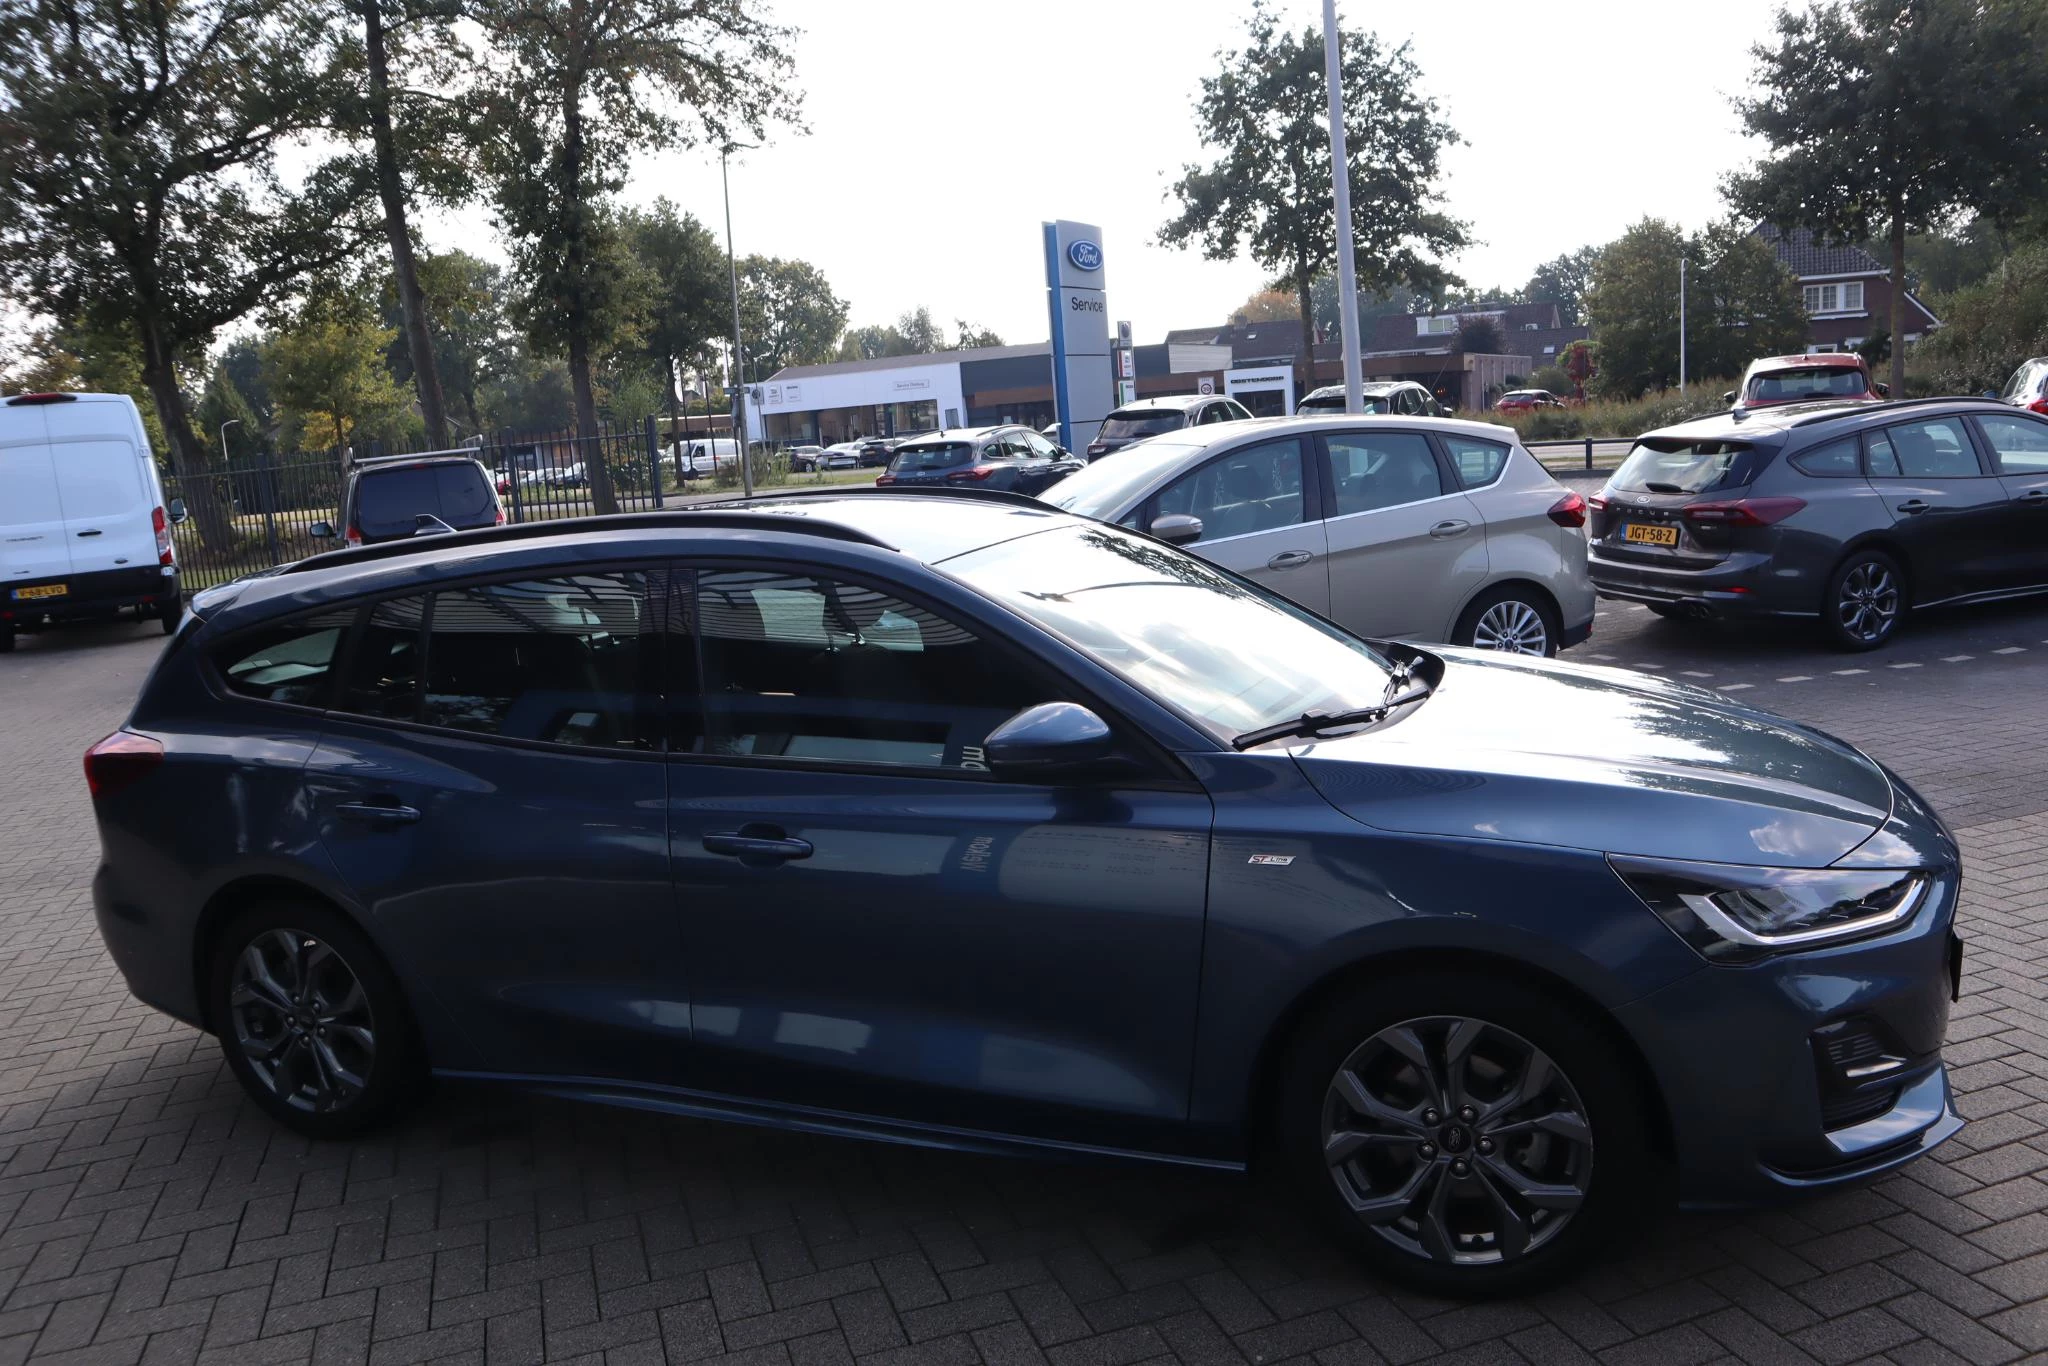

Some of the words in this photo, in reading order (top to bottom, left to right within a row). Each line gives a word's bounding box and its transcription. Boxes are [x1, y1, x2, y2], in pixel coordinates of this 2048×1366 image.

[1078, 244, 1098, 265] Ford
[1071, 296, 1103, 313] Service
[1629, 524, 1673, 543] JGT-58-Z
